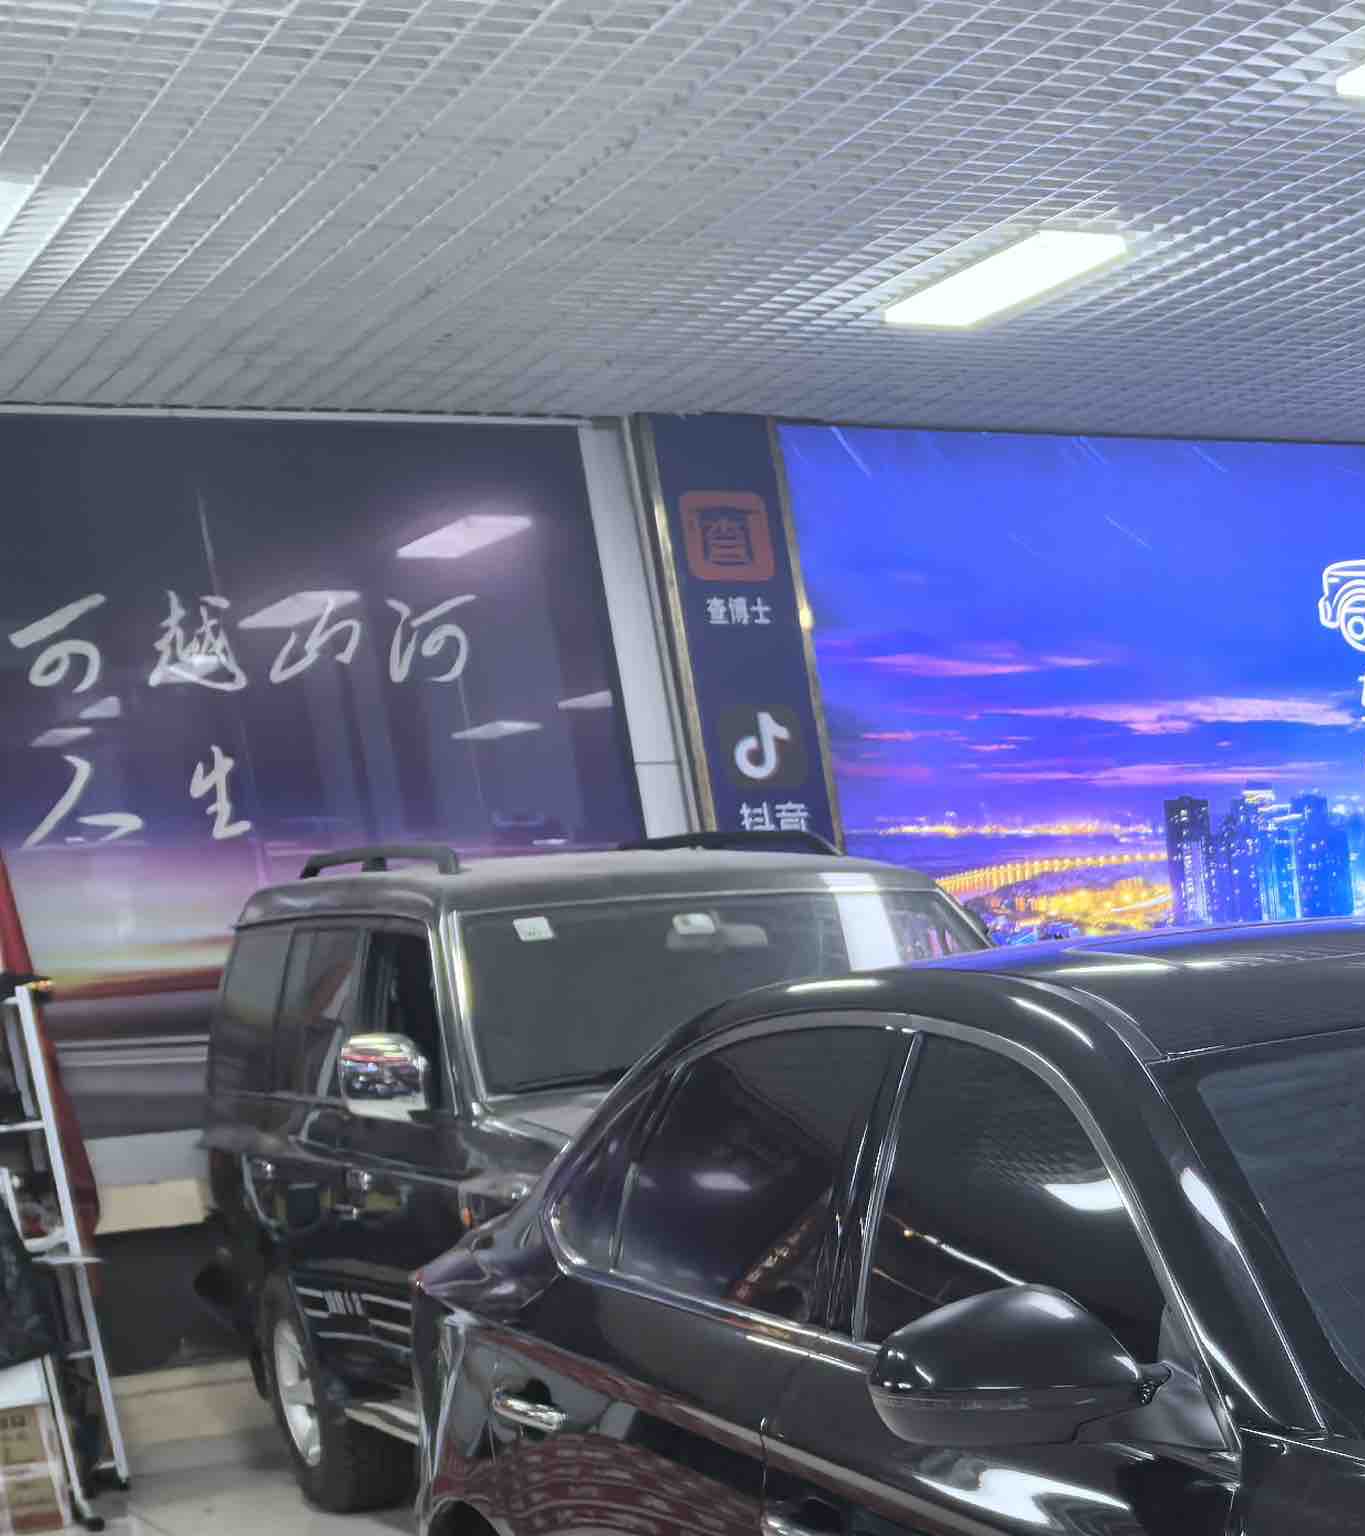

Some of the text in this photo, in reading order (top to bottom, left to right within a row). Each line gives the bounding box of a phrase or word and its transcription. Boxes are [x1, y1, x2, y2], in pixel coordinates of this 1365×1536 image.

[706, 596, 772, 625] 查博士
[739, 802, 810, 832] 抖音
